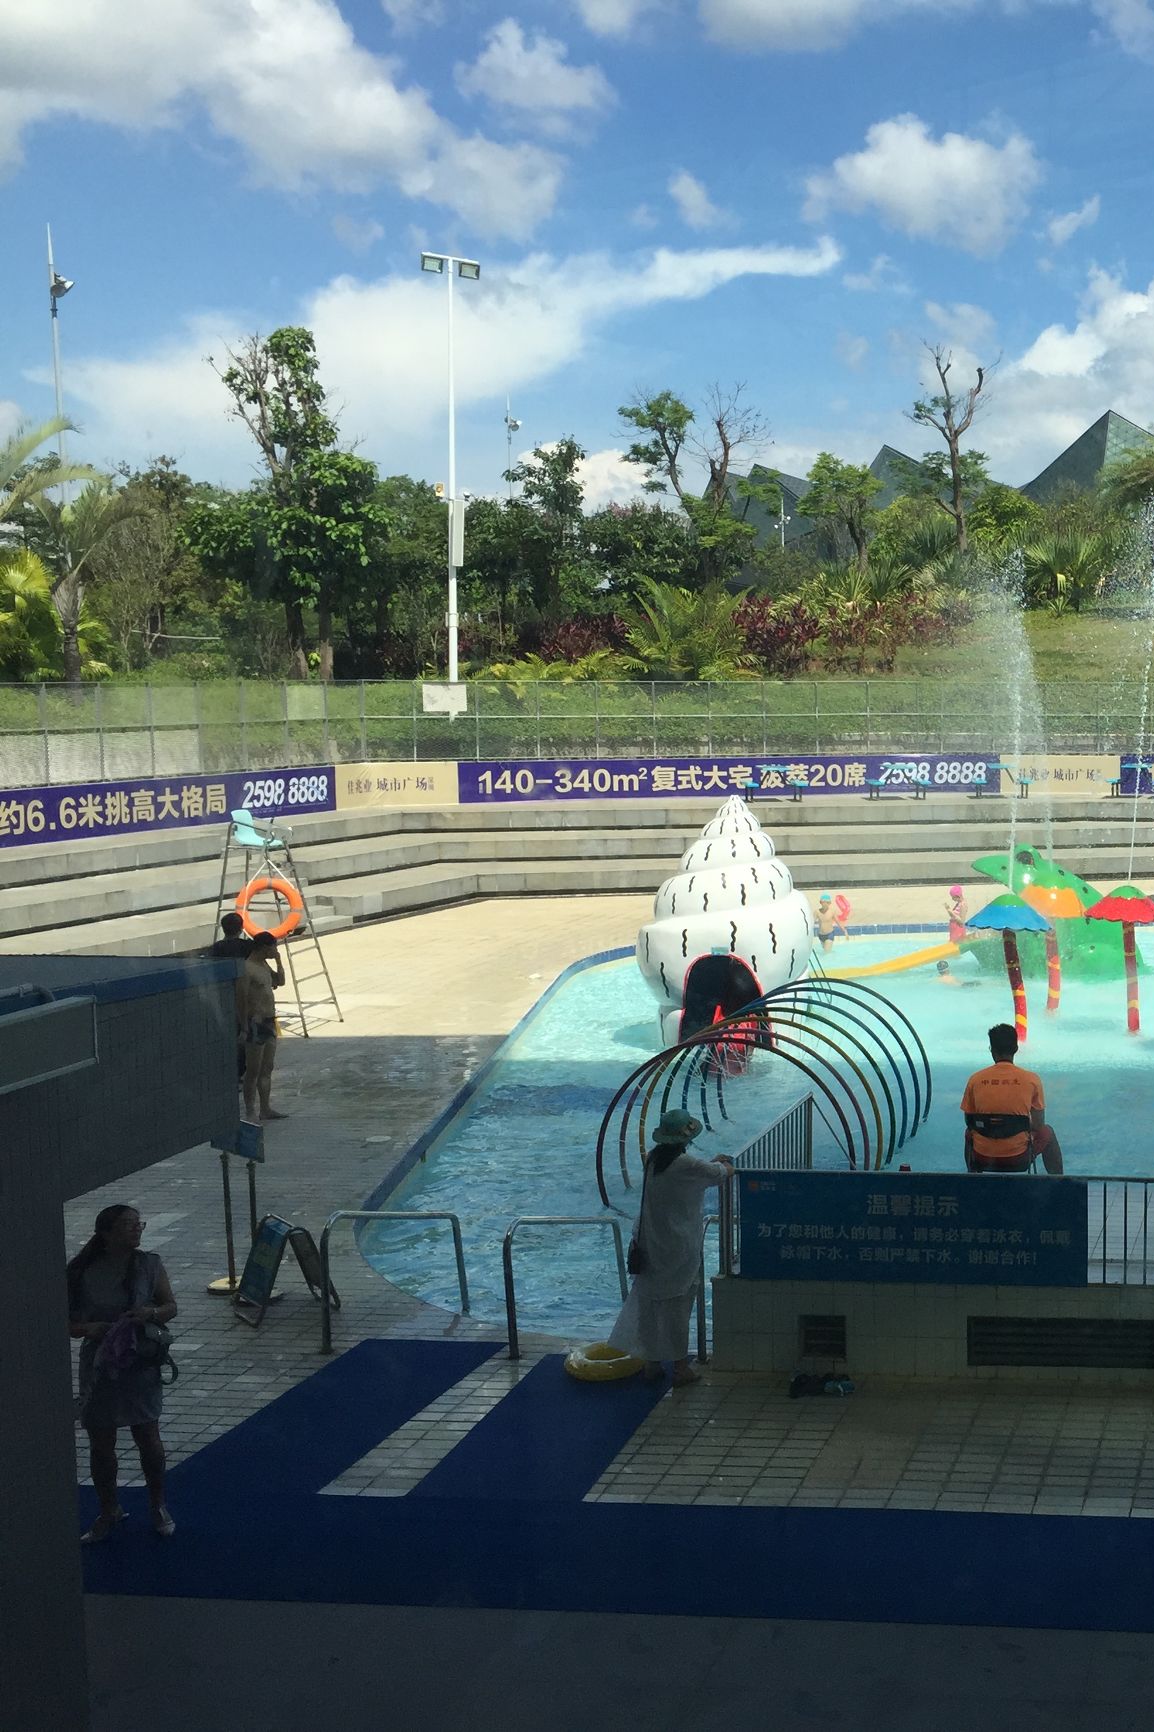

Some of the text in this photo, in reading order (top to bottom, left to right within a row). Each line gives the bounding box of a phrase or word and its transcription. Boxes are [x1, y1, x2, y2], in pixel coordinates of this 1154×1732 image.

[879, 762, 987, 785] 2598 8888
[241, 777, 284, 809] 2598
[288, 775, 328, 803] 8888
[0, 783, 227, 836] 约6.6米挑高大格局
[867, 1194, 959, 1217] 温馨提示
